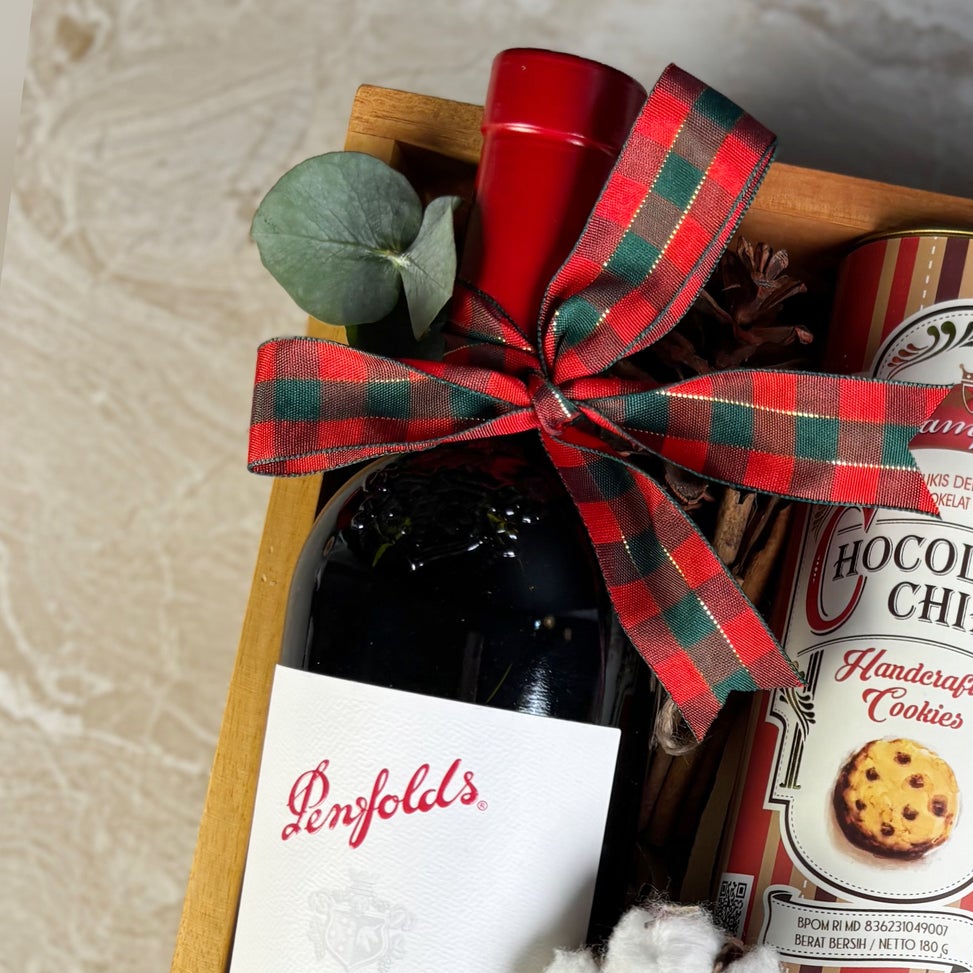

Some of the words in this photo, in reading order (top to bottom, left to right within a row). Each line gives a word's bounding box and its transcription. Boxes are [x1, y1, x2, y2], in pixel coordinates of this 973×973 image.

[861, 687, 964, 730] Cookies
[797, 916, 830, 931] BPOM
[831, 918, 843, 931] RI
[845, 919, 861, 932] MD
[864, 919, 949, 937] 836231049007
[794, 933, 826, 948] BERAT
[828, 936, 868, 950] BERSIH
[879, 938, 916, 952] NETTO
[919, 939, 939, 953] 180
